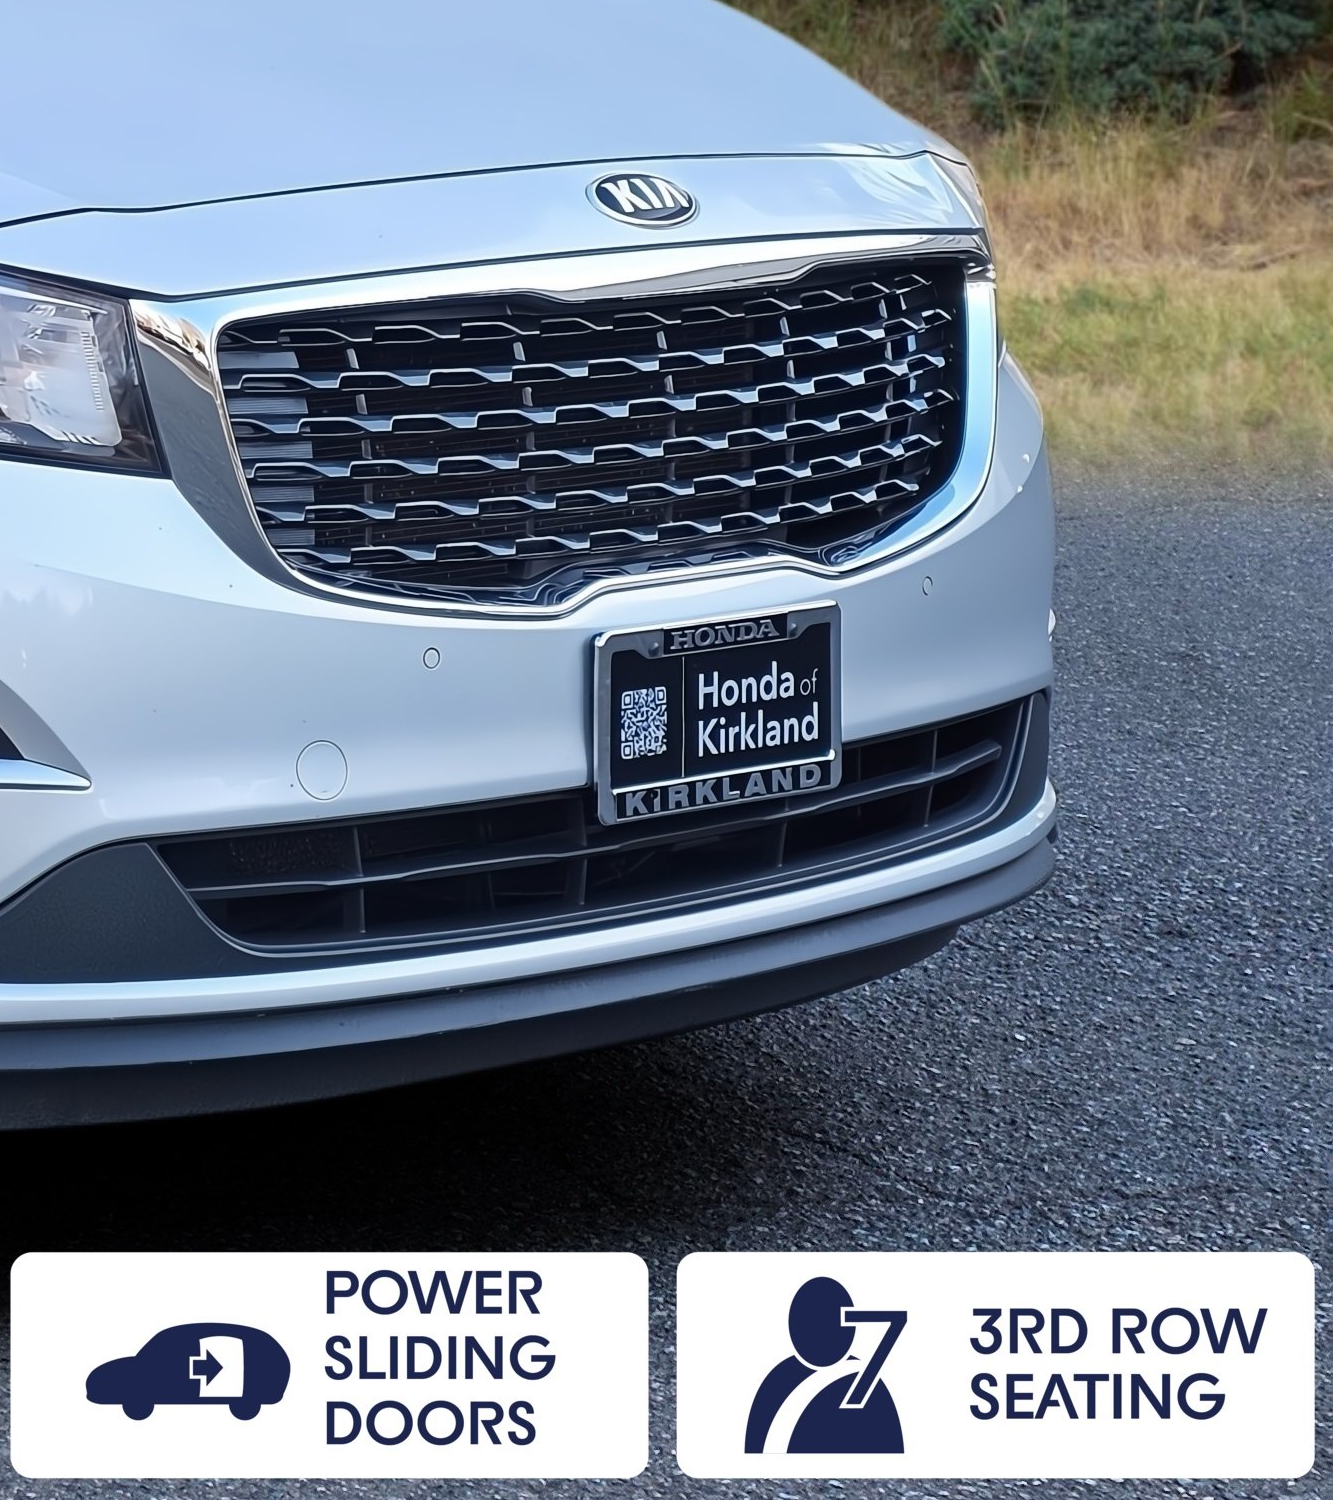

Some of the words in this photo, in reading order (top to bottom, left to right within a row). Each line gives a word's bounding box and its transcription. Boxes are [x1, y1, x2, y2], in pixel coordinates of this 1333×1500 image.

[600, 177, 690, 213] KIA
[670, 619, 780, 650] HONDA
[697, 660, 795, 710] Honda
[800, 667, 819, 696] of
[697, 702, 820, 757] Kirkland
[625, 763, 822, 817] KIRKLAND
